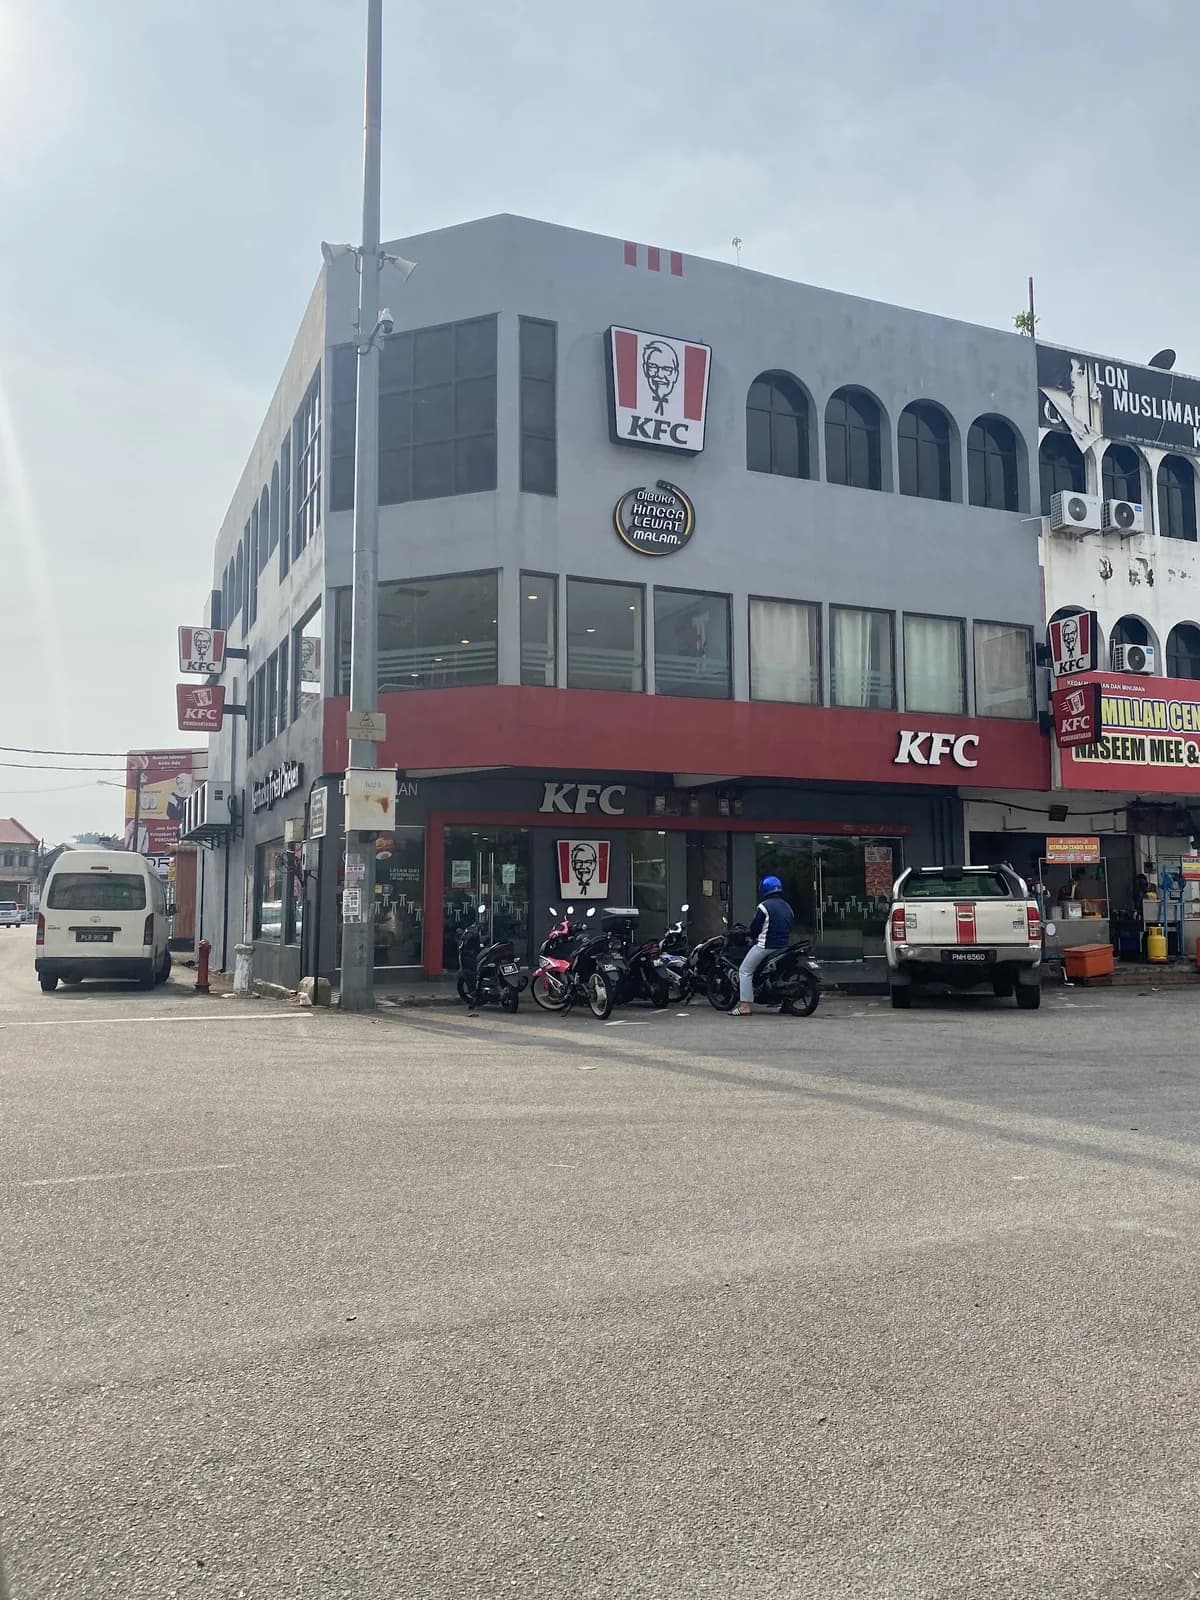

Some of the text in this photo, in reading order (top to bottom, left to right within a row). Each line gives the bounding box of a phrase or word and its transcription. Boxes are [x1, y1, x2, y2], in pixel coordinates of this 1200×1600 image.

[627, 415, 689, 445] KFC
[636, 491, 676, 505] DIBUKA
[633, 514, 682, 532] LEWAT
[186, 660, 216, 672] KFC
[1058, 657, 1085, 674] KFC
[184, 708, 217, 719] KFC
[1102, 698, 1167, 729] MILLAH
[1061, 715, 1091, 733] KFC
[894, 730, 980, 767] KFC
[1075, 737, 1200, 764] NASEEM MEE &
[538, 782, 627, 815] KFC
[951, 953, 986, 961] PMH 6560
